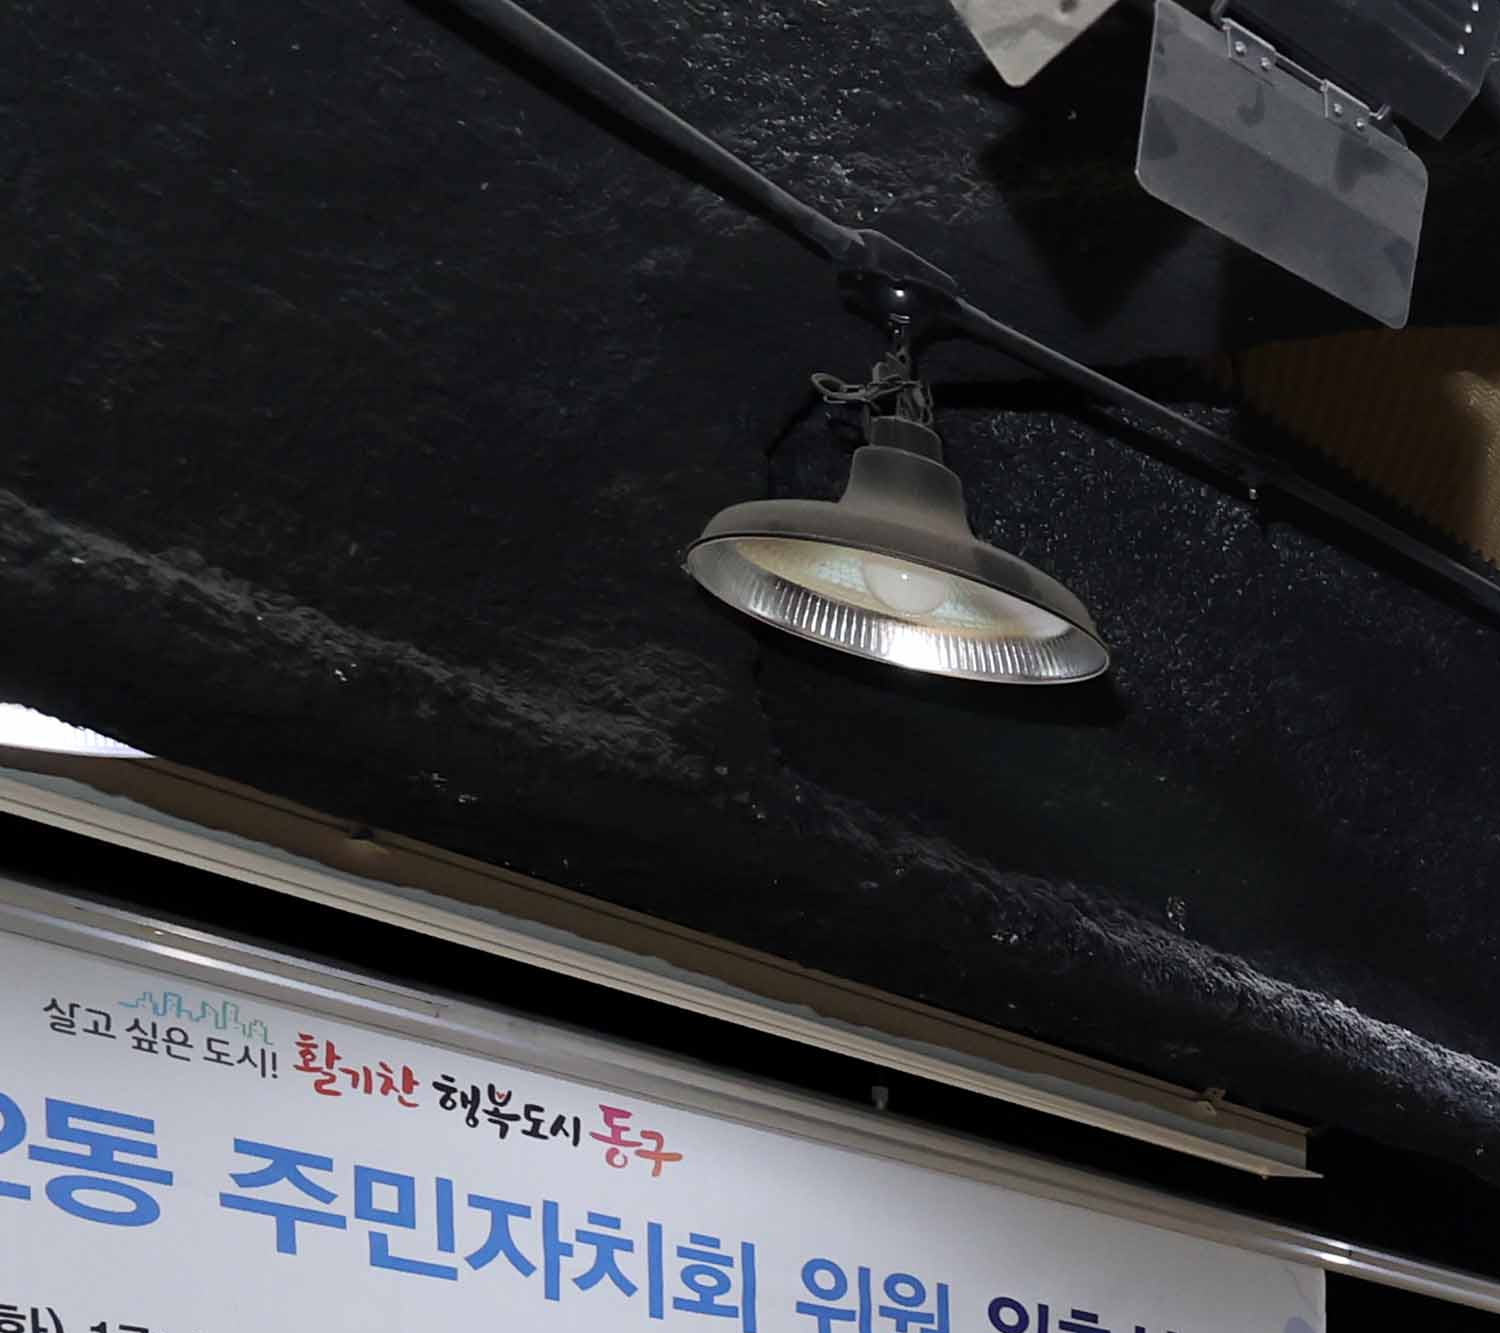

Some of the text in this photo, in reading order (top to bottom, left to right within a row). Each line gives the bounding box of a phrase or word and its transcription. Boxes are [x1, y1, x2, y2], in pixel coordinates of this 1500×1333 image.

[43, 998, 683, 1177] 살고 싶은 도시! 활기찬 행복도시 동구
